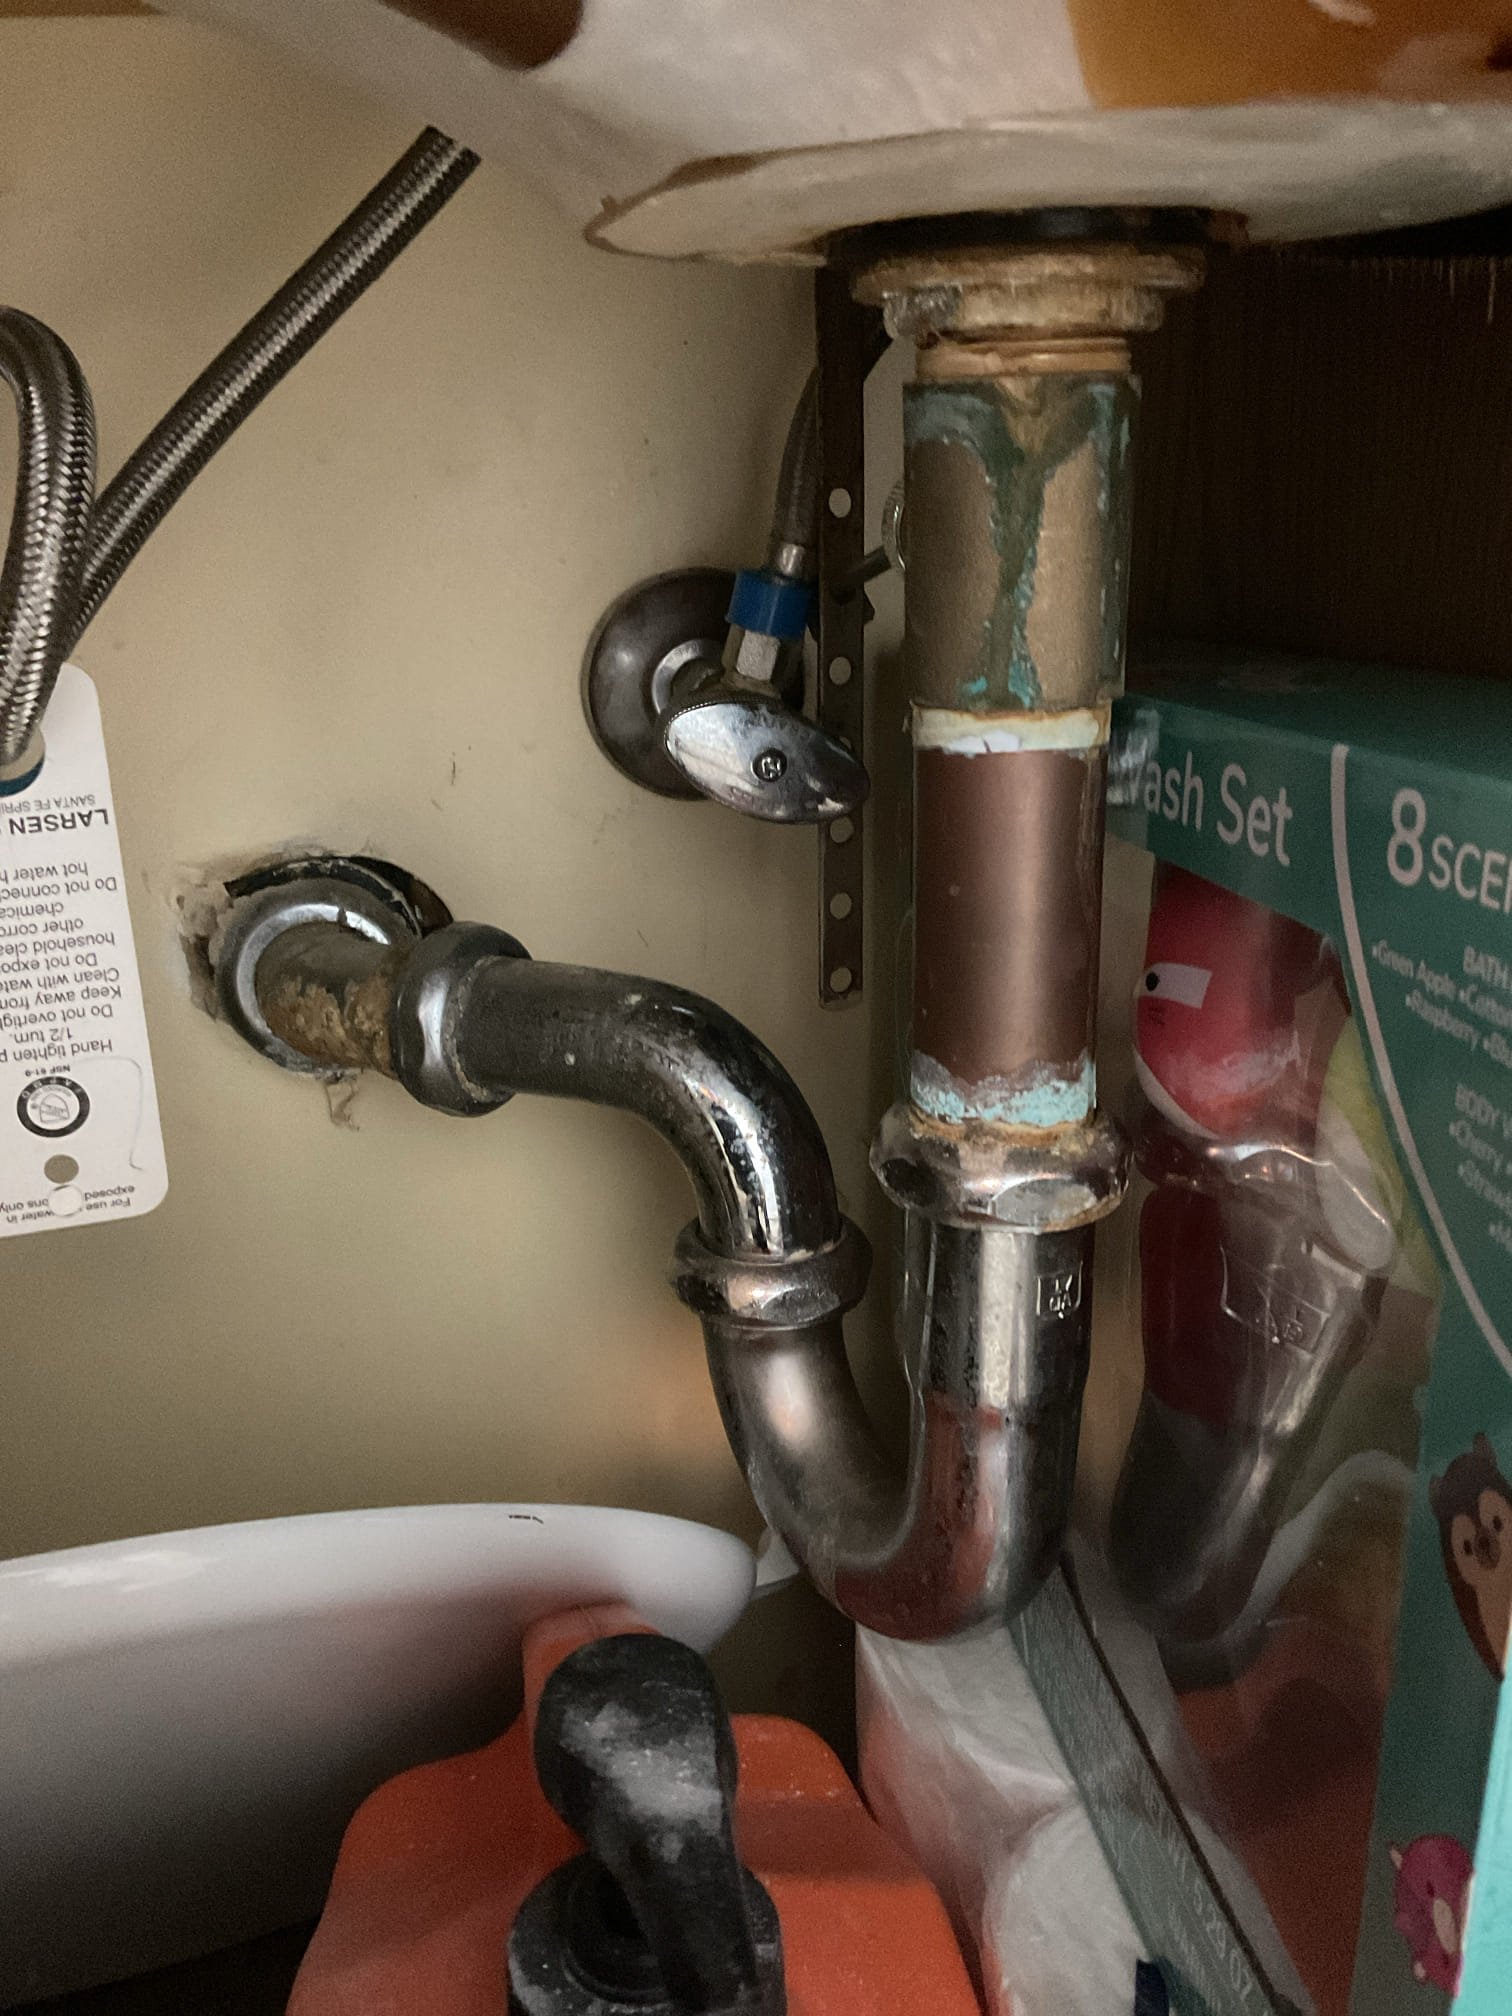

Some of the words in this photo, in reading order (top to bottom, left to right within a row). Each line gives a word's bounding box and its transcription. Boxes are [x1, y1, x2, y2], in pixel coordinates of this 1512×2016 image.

[35, 799, 51, 812] FE
[54, 794, 95, 809] SANTA
[9, 808, 108, 835] LARSEN
[1216, 762, 1293, 867] Set
[1387, 787, 1427, 886] 8
[13, 864, 59, 881] water
[63, 861, 88, 877] hot
[64, 880, 90, 895] not
[95, 877, 117, 891] Do
[42, 918, 84, 933] other
[33, 931, 115, 955] household
[44, 956, 70, 971] not
[75, 952, 97, 967] Do
[36, 974, 69, 990] with
[73, 967, 119, 983] Clean
[35, 991, 75, 1006] away
[81, 985, 122, 1000] Keep
[61, 1007, 85, 1023] not
[90, 1004, 113, 1018] Do
[48, 1027, 72, 1042] 1/2
[13, 1043, 66, 1060] tighten
[71, 1039, 113, 1056] Hand
[83, 1185, 135, 1200] exposed
[86, 1201, 108, 1210] use
[111, 1197, 131, 1207] For
[6, 1215, 18, 1223] in
